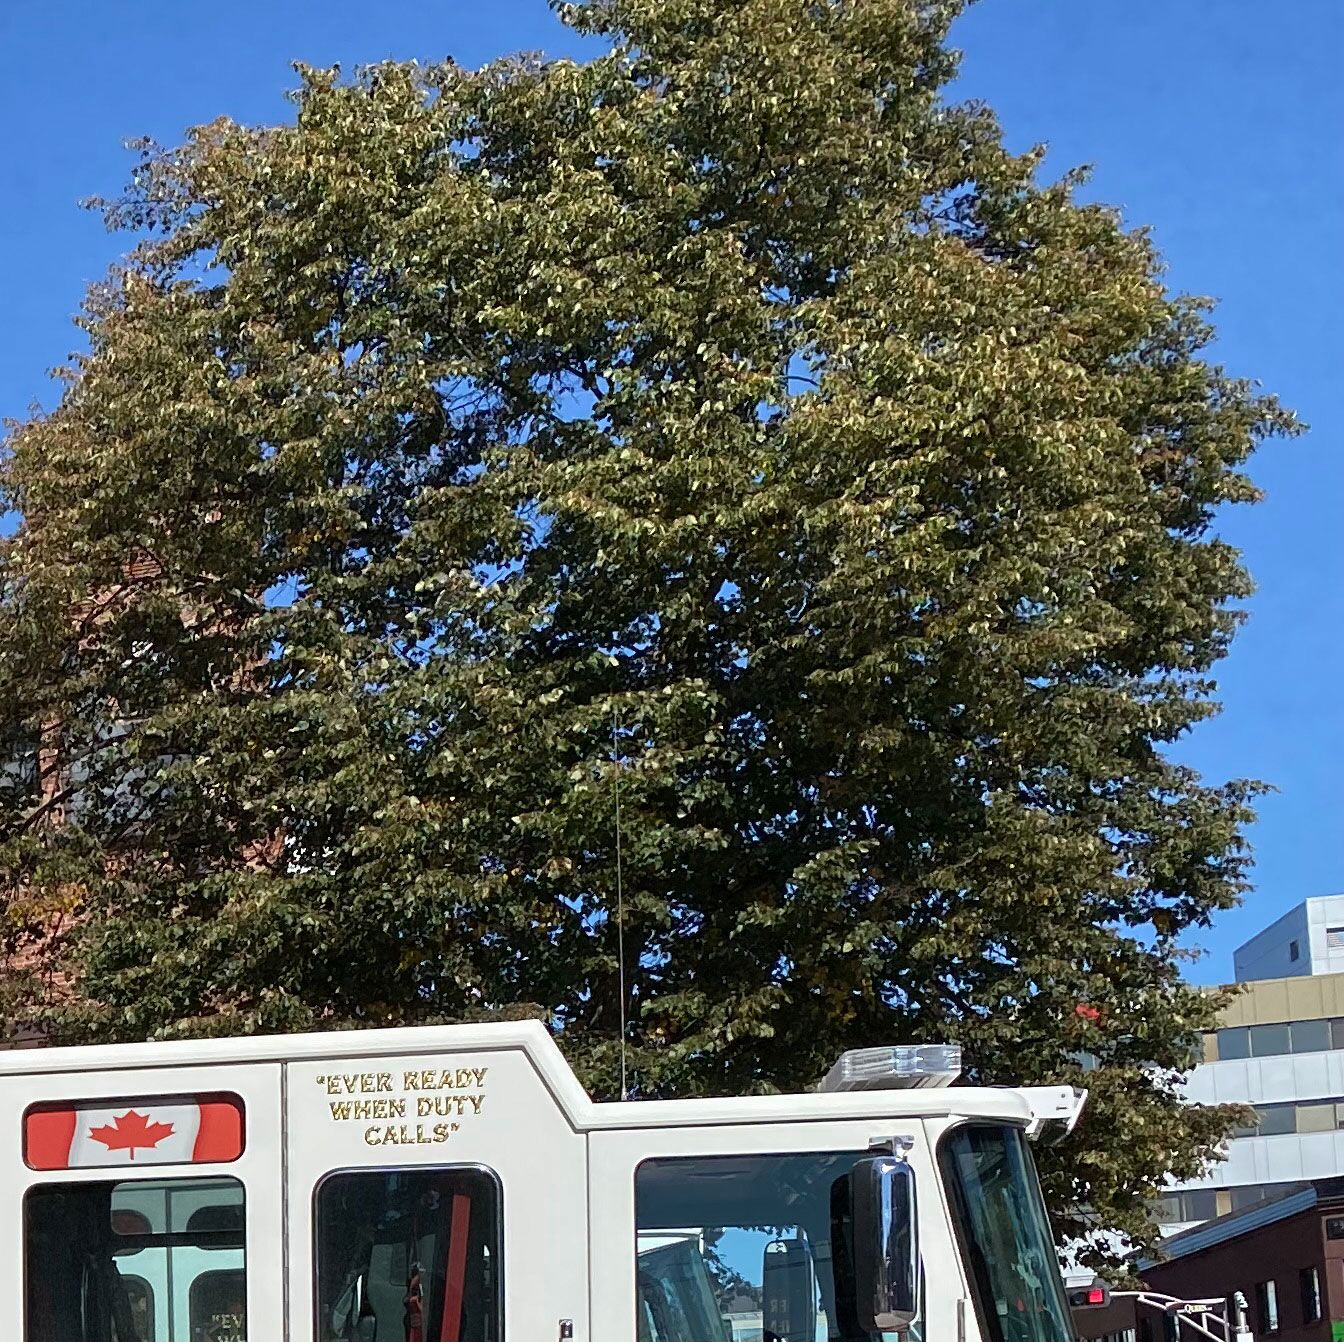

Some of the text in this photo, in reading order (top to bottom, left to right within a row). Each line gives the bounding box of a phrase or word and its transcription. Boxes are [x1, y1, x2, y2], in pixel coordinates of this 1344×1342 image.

[403, 1067, 489, 1091] READY
[329, 1095, 486, 1121] WHEN DUTY
